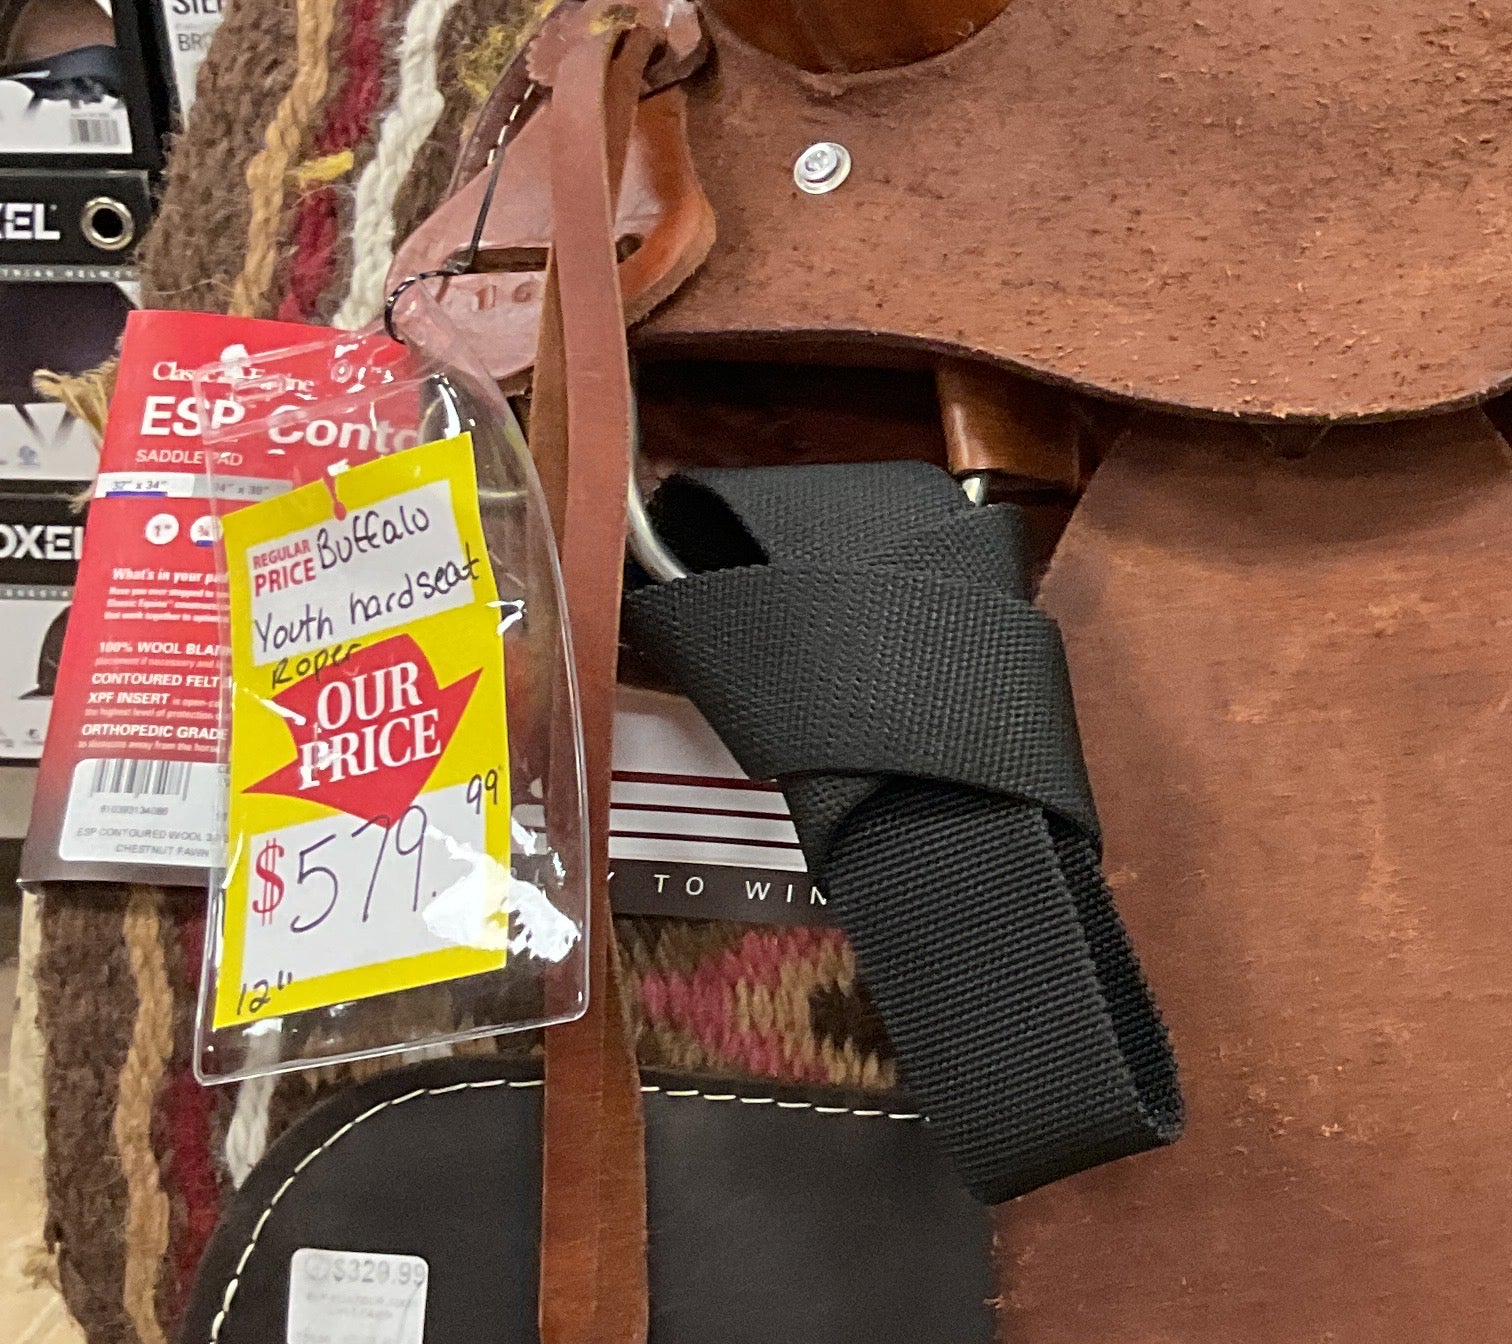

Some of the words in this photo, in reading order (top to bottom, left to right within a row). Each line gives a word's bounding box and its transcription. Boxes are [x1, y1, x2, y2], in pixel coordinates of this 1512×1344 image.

[0, 203, 60, 241] EL
[140, 395, 246, 438] ESP
[135, 448, 202, 465] SADDLE
[252, 538, 311, 570] REGULAR
[254, 556, 317, 597] PRICE
[254, 603, 334, 653] Youth
[137, 641, 182, 655] WOOL
[91, 672, 183, 687] CONTOURED
[185, 674, 220, 689] FELT
[316, 661, 424, 732] OUR
[87, 691, 116, 705] XPF
[116, 692, 171, 706] INSERT
[81, 723, 174, 738] ORTHOPEDIC
[298, 708, 443, 792] PRICE
[653, 873, 705, 897] TO
[745, 880, 828, 906] WIN
